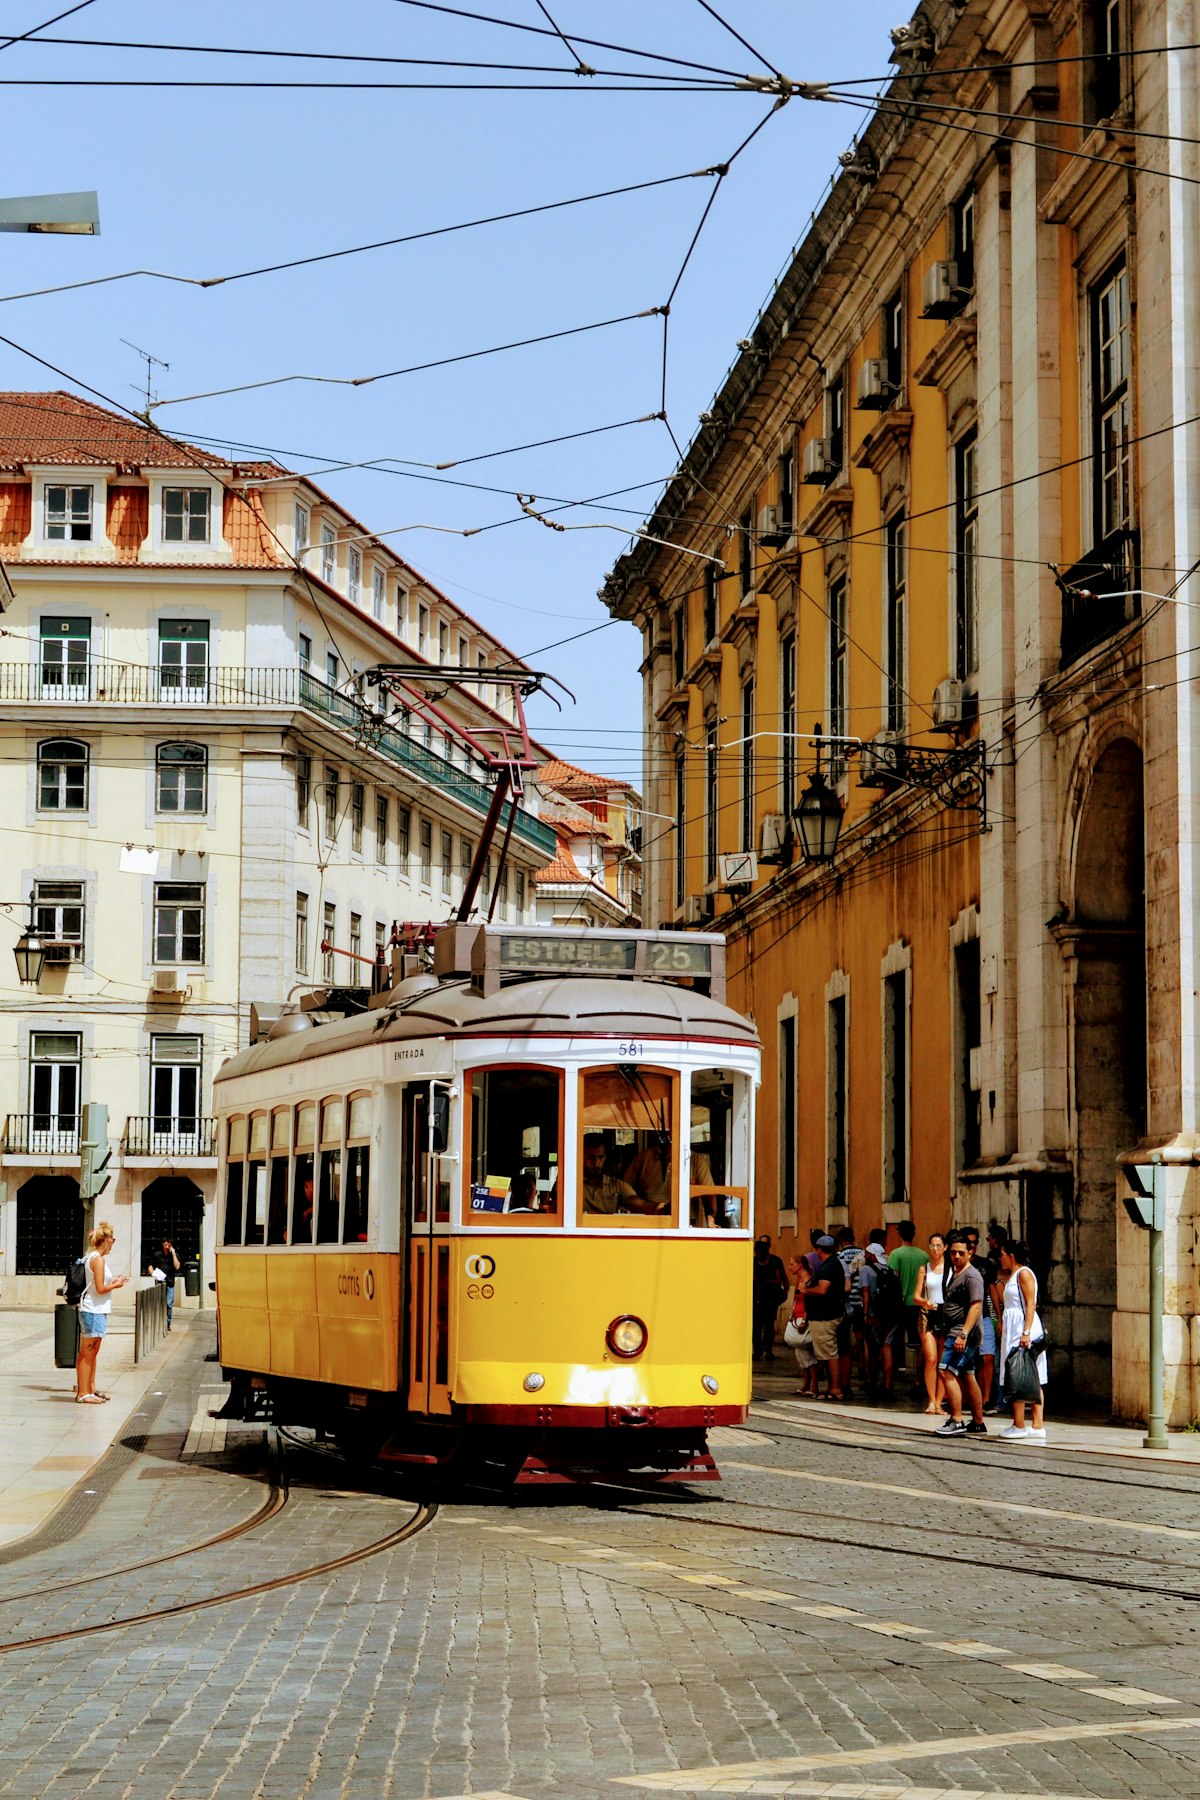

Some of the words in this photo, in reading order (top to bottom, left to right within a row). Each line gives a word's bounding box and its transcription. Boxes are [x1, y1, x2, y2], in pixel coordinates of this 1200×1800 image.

[508, 939, 625, 962] ESTRELA
[651, 943, 691, 970] 25
[394, 1048, 425, 1061] ENTRADA
[618, 1043, 644, 1057] 581
[472, 1199, 485, 1209] 01
[338, 1268, 360, 1297] carris
